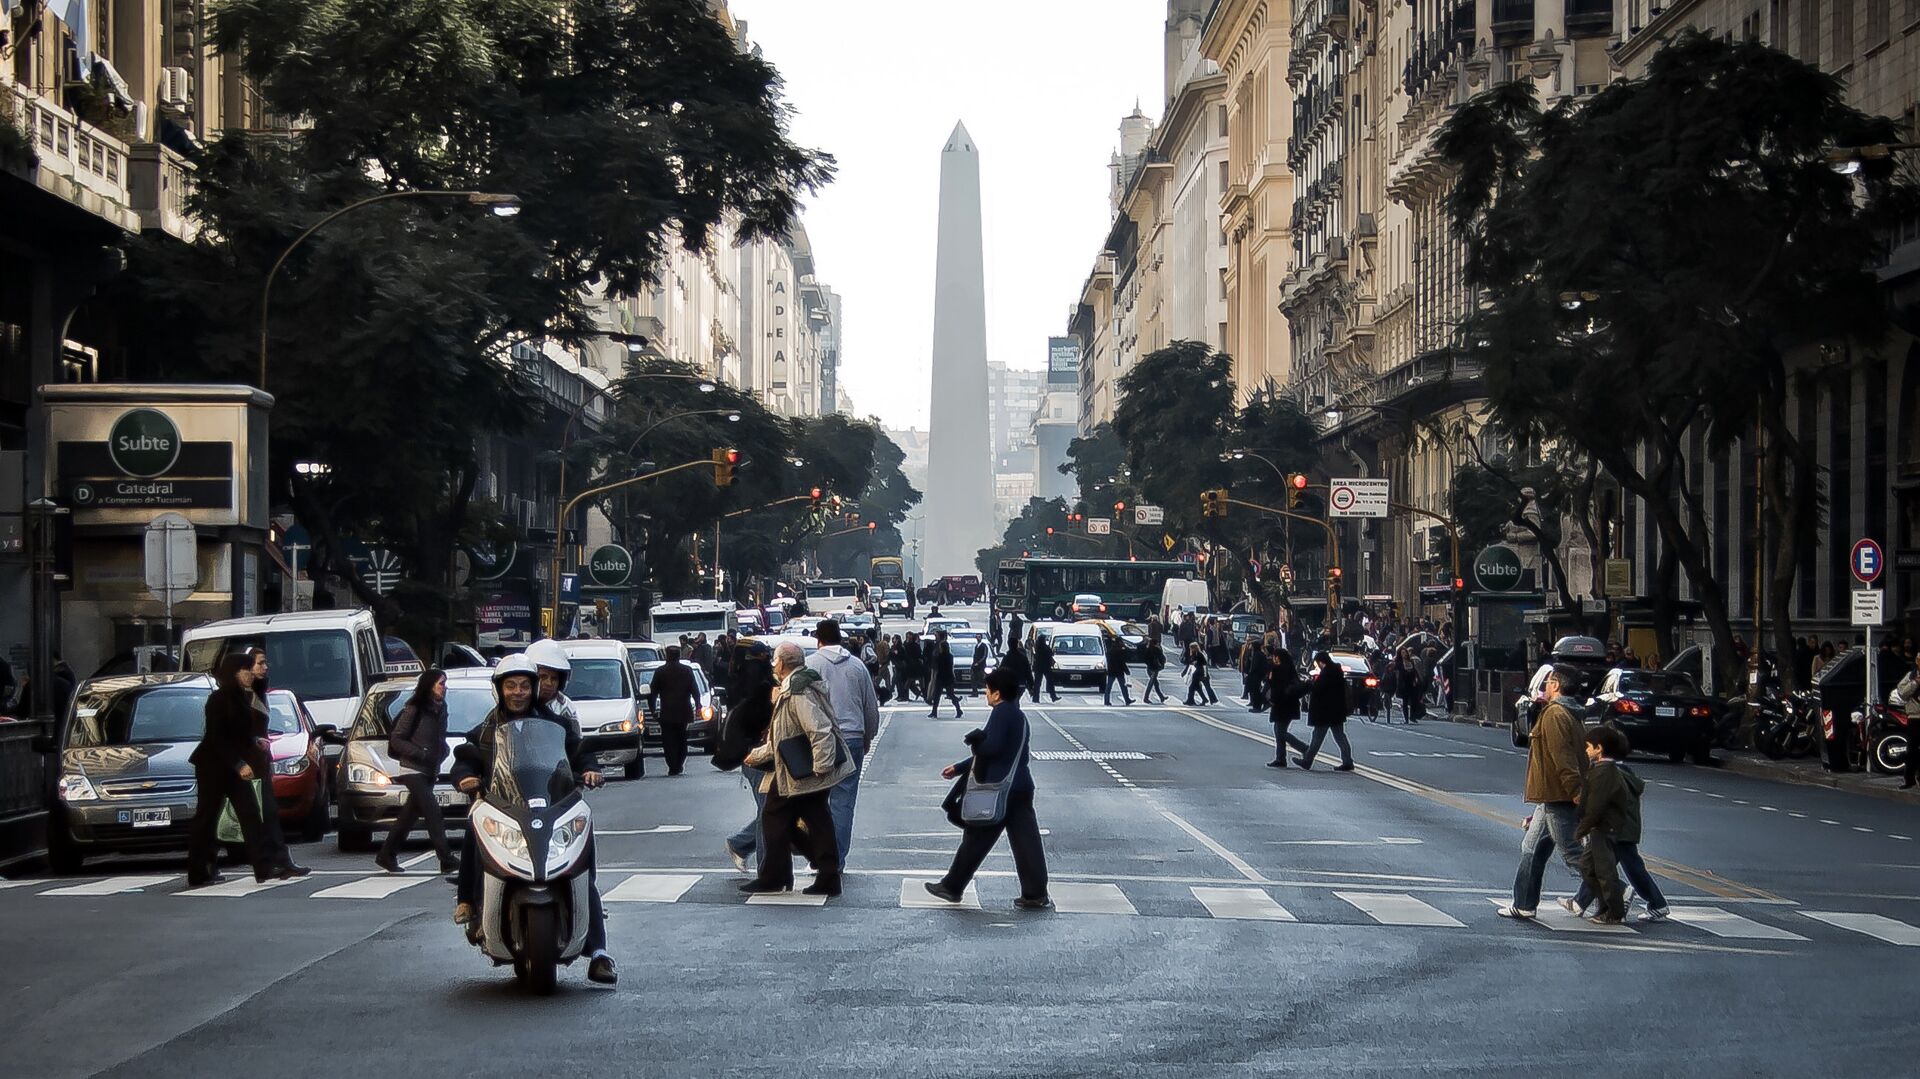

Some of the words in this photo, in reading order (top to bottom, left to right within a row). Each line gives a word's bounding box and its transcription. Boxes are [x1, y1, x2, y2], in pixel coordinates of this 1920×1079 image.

[119, 434, 170, 451] Subte
[78, 488, 89, 500] D
[117, 482, 173, 495] Catedral
[105, 496, 143, 505] Congreso
[144, 496, 155, 504] de
[593, 560, 627, 571] Subte
[1860, 547, 1873, 574] E
[1479, 563, 1518, 576] Subte
